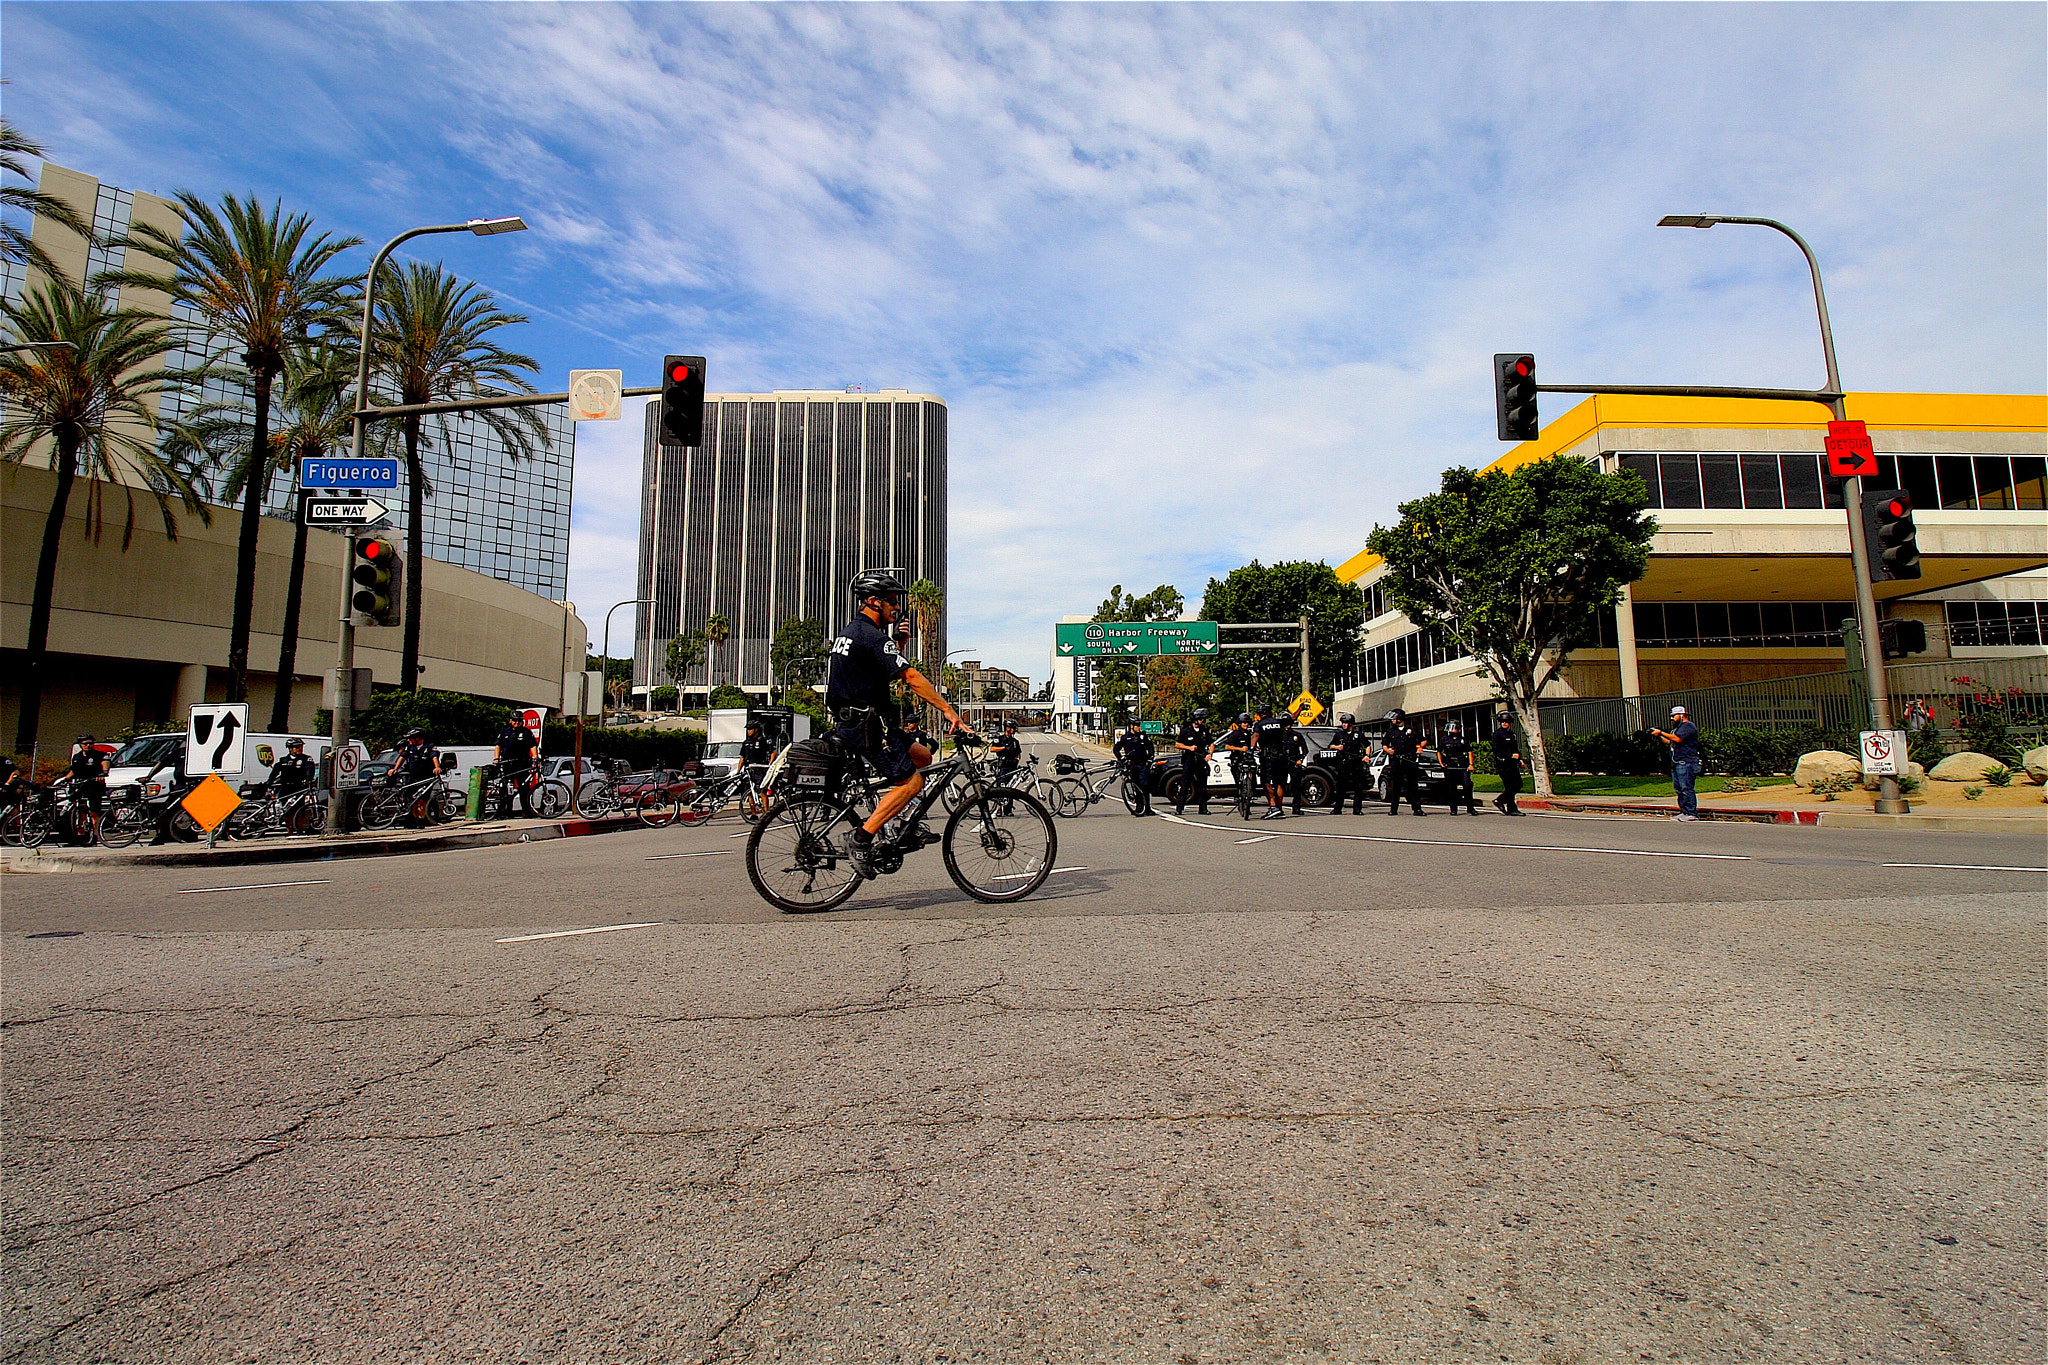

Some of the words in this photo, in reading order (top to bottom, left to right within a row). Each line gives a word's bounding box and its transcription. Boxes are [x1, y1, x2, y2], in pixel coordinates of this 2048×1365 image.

[1830, 440, 1869, 450] DETOUR
[309, 464, 391, 484] Figueroa
[315, 506, 338, 516] ONE
[342, 506, 365, 516] WAY
[1109, 629, 1142, 637] Harbor
[1148, 629, 1188, 638] Freeway
[527, 718, 539, 727] NOT
[258, 752, 273, 764] ups
